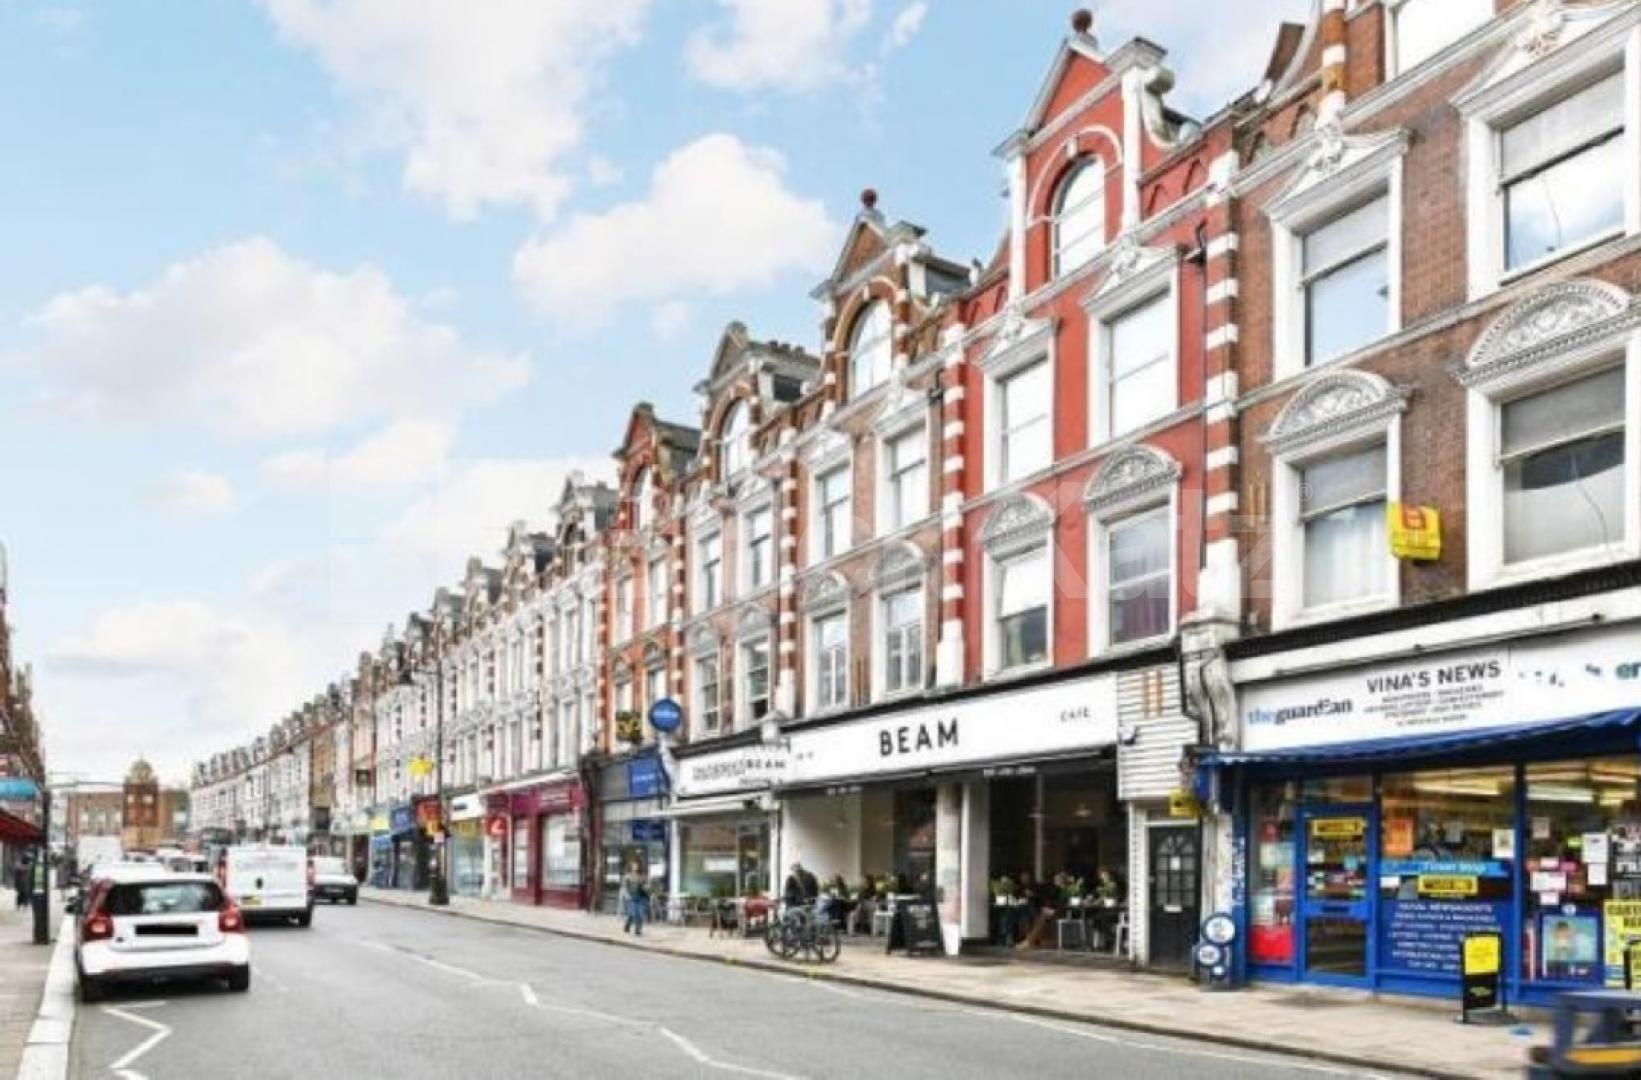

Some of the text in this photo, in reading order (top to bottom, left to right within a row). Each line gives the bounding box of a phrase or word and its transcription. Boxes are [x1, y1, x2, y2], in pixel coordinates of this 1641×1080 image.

[1366, 669, 1431, 694] VINA'S
[1437, 660, 1502, 686] NEWS
[879, 717, 959, 758] BEAM
